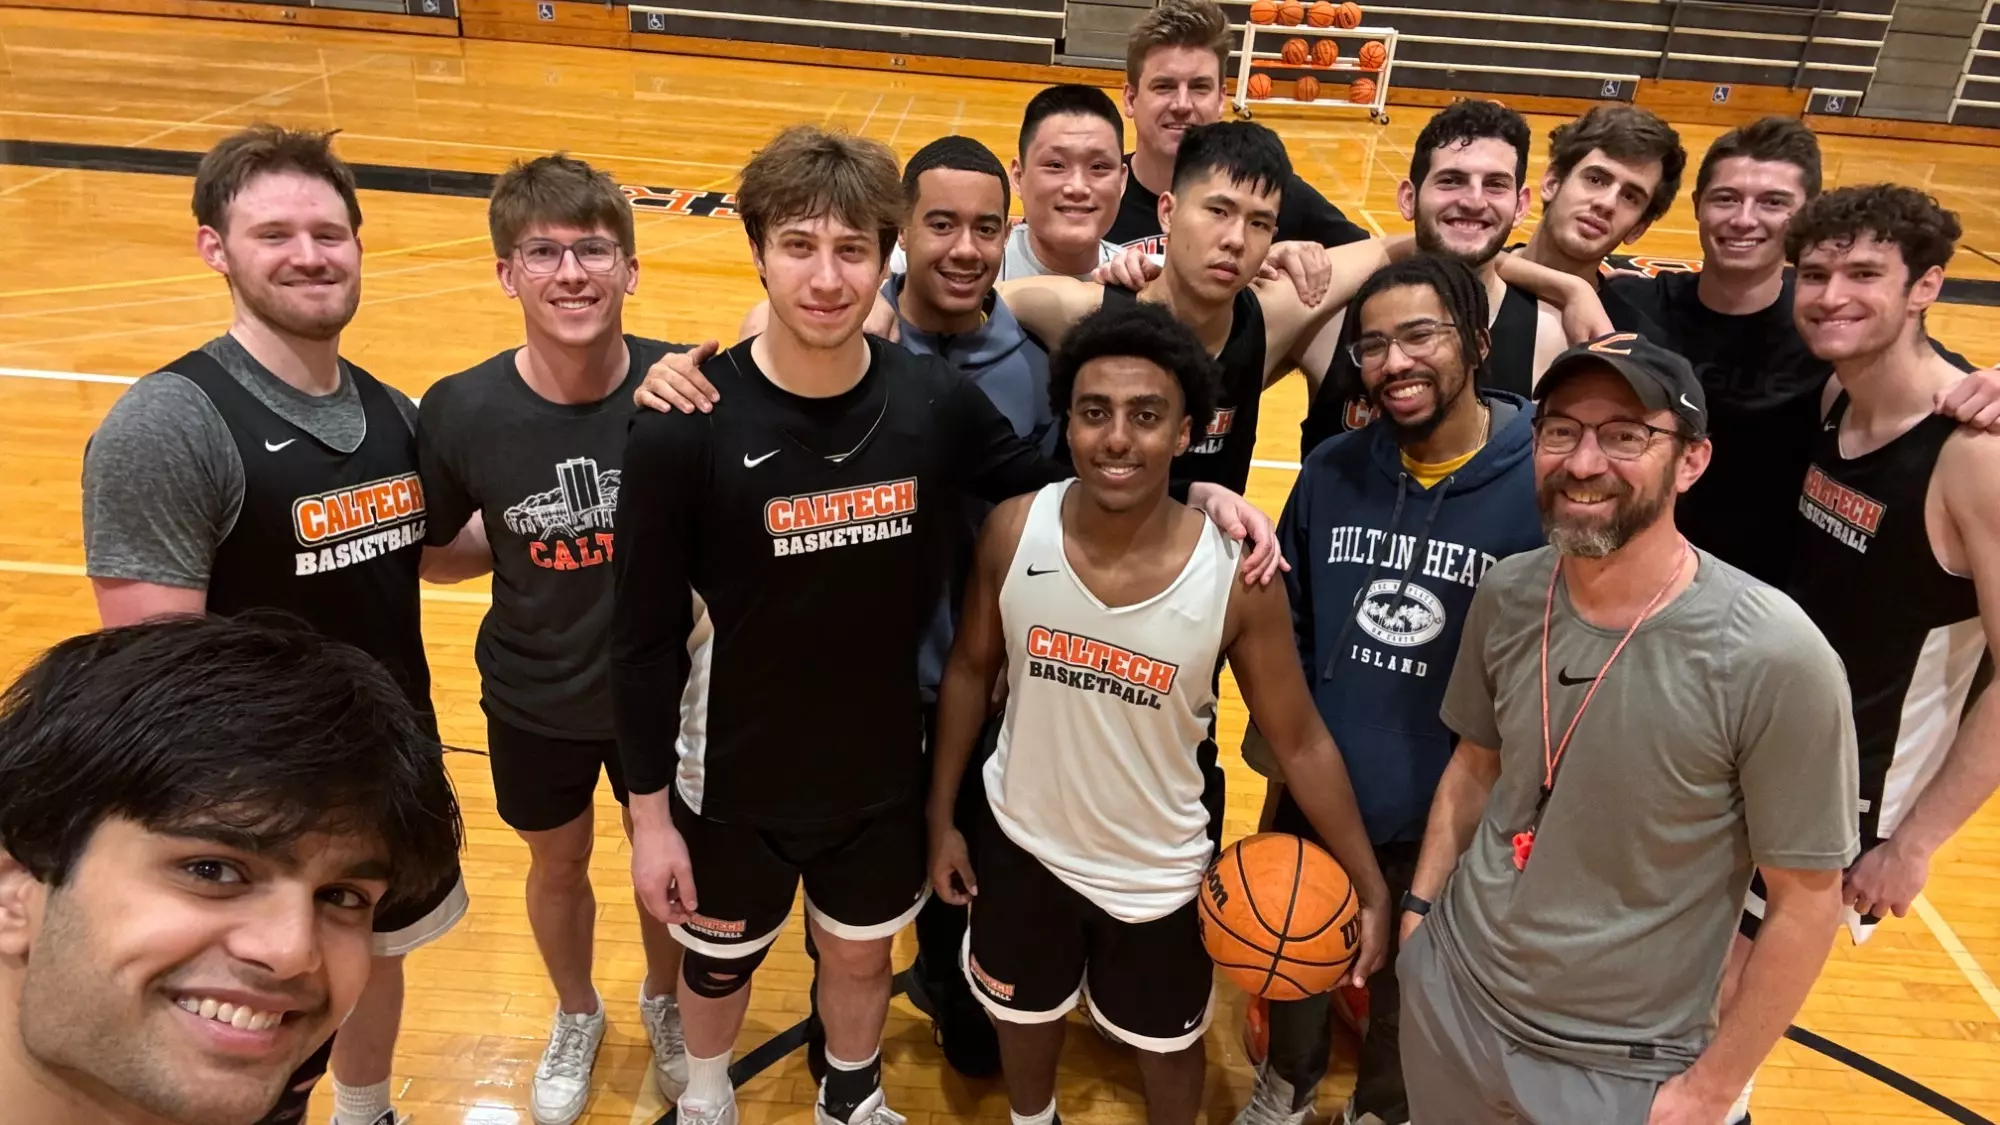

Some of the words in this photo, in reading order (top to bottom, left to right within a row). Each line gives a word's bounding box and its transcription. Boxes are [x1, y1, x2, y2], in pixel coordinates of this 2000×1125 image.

[295, 474, 425, 542] CALTECH
[766, 478, 917, 534] CALTECH
[295, 519, 426, 576] BASKETBALL
[773, 517, 913, 557] BASKETBALL
[1028, 625, 1178, 695] CALTECH
[1029, 661, 1161, 710] BASKETBALL
[1351, 645, 1427, 677] ISLAND
